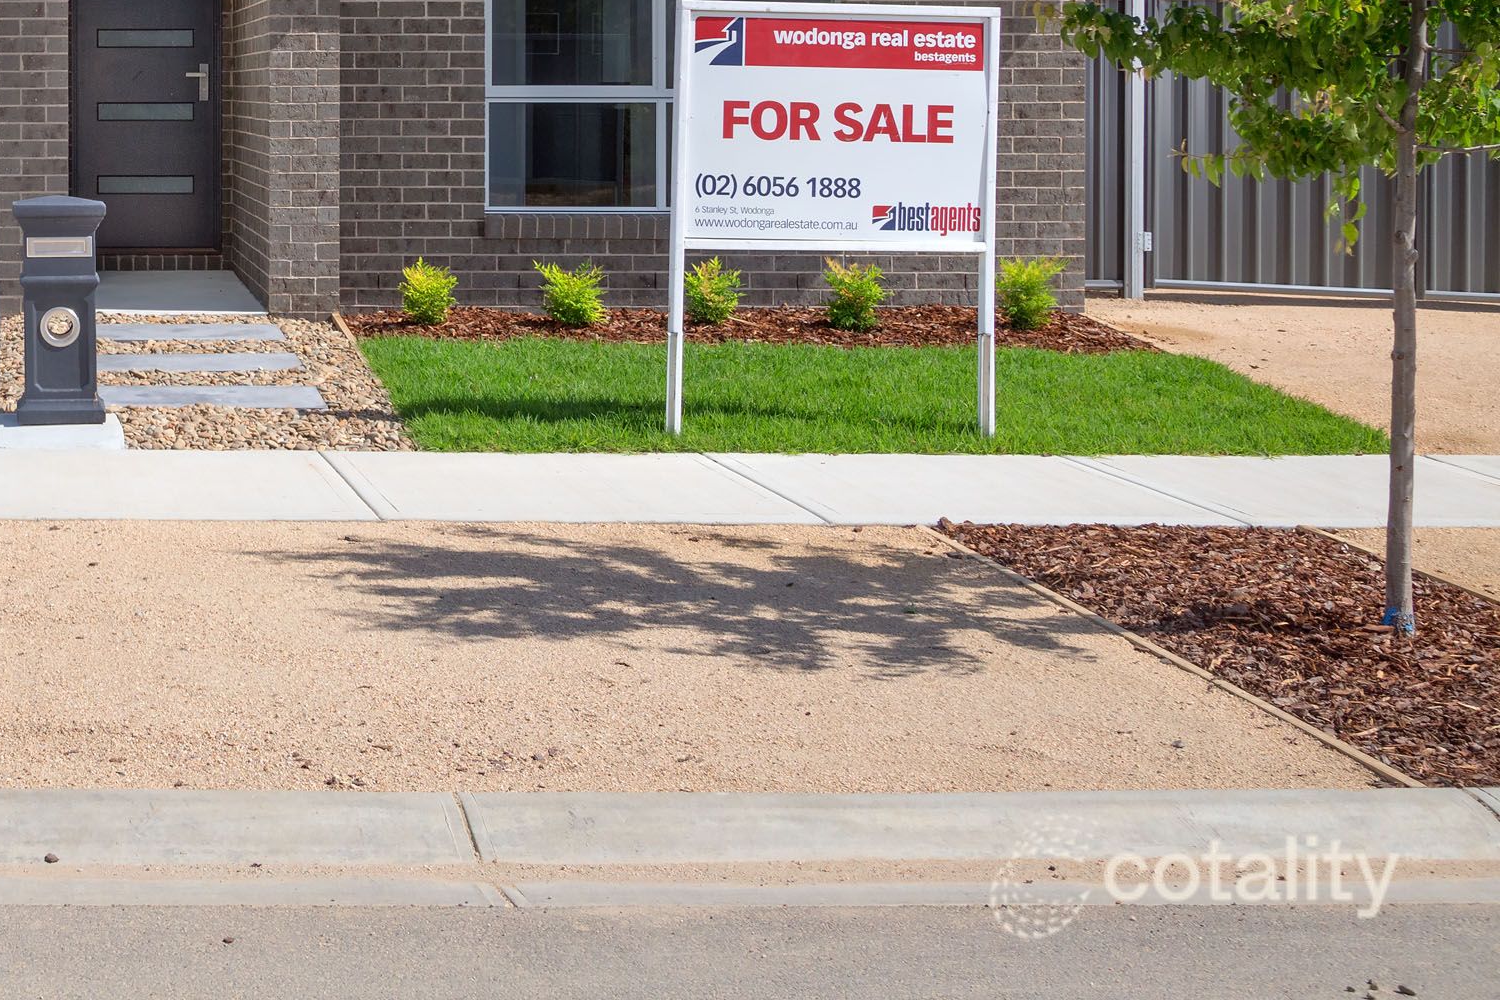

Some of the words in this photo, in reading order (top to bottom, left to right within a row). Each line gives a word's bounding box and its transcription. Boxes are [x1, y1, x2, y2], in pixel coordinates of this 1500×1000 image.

[774, 28, 866, 49] wodonga
[871, 30, 908, 47] real
[914, 33, 976, 48] estate
[914, 51, 976, 63] bestagents
[722, 100, 820, 141] FOR
[833, 102, 954, 144] SALE
[695, 173, 737, 198] (02)
[743, 176, 799, 197] 6056
[806, 177, 861, 198] 1888
[702, 206, 727, 215] Stanley
[741, 207, 774, 216] Wodonga
[898, 202, 981, 236] bestagents
[695, 218, 858, 230] www.wodongarealestate.com.au
